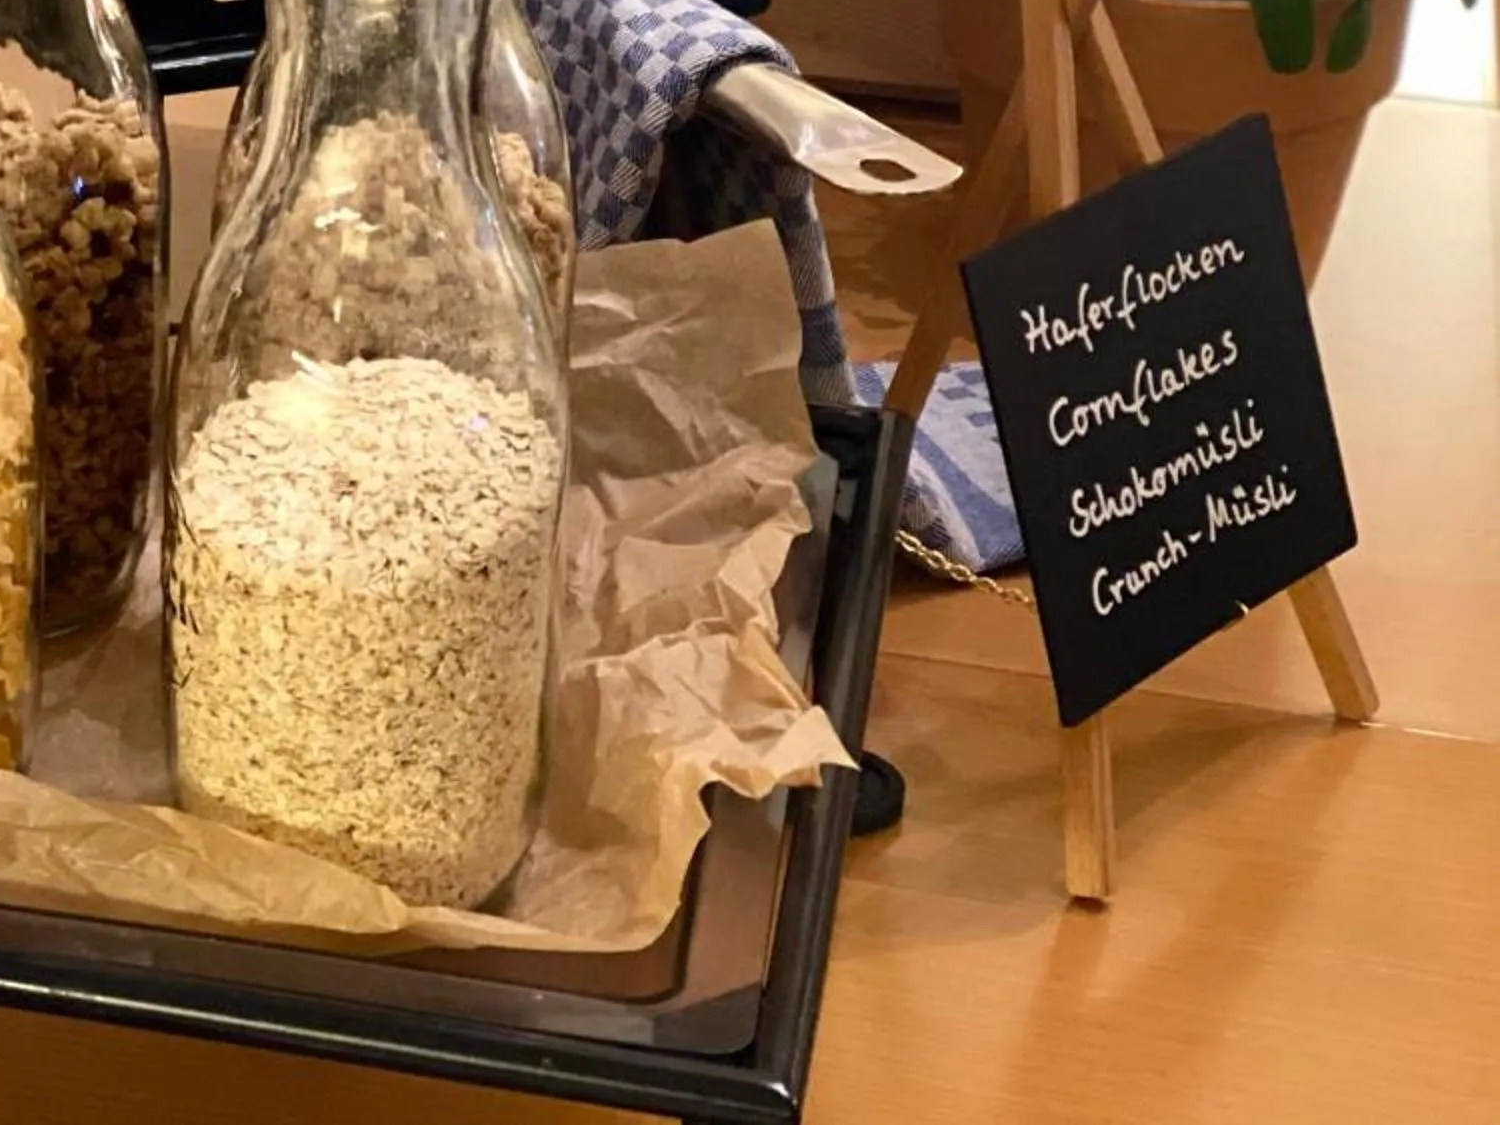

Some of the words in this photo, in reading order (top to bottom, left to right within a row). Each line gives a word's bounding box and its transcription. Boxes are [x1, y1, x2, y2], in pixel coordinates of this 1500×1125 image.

[1021, 238, 1245, 354] Haferflocken
[1048, 330, 1238, 447] Cornflakes
[1069, 399, 1264, 538] Schokomüsli
[1092, 465, 1297, 616] Crunch-Müsli
